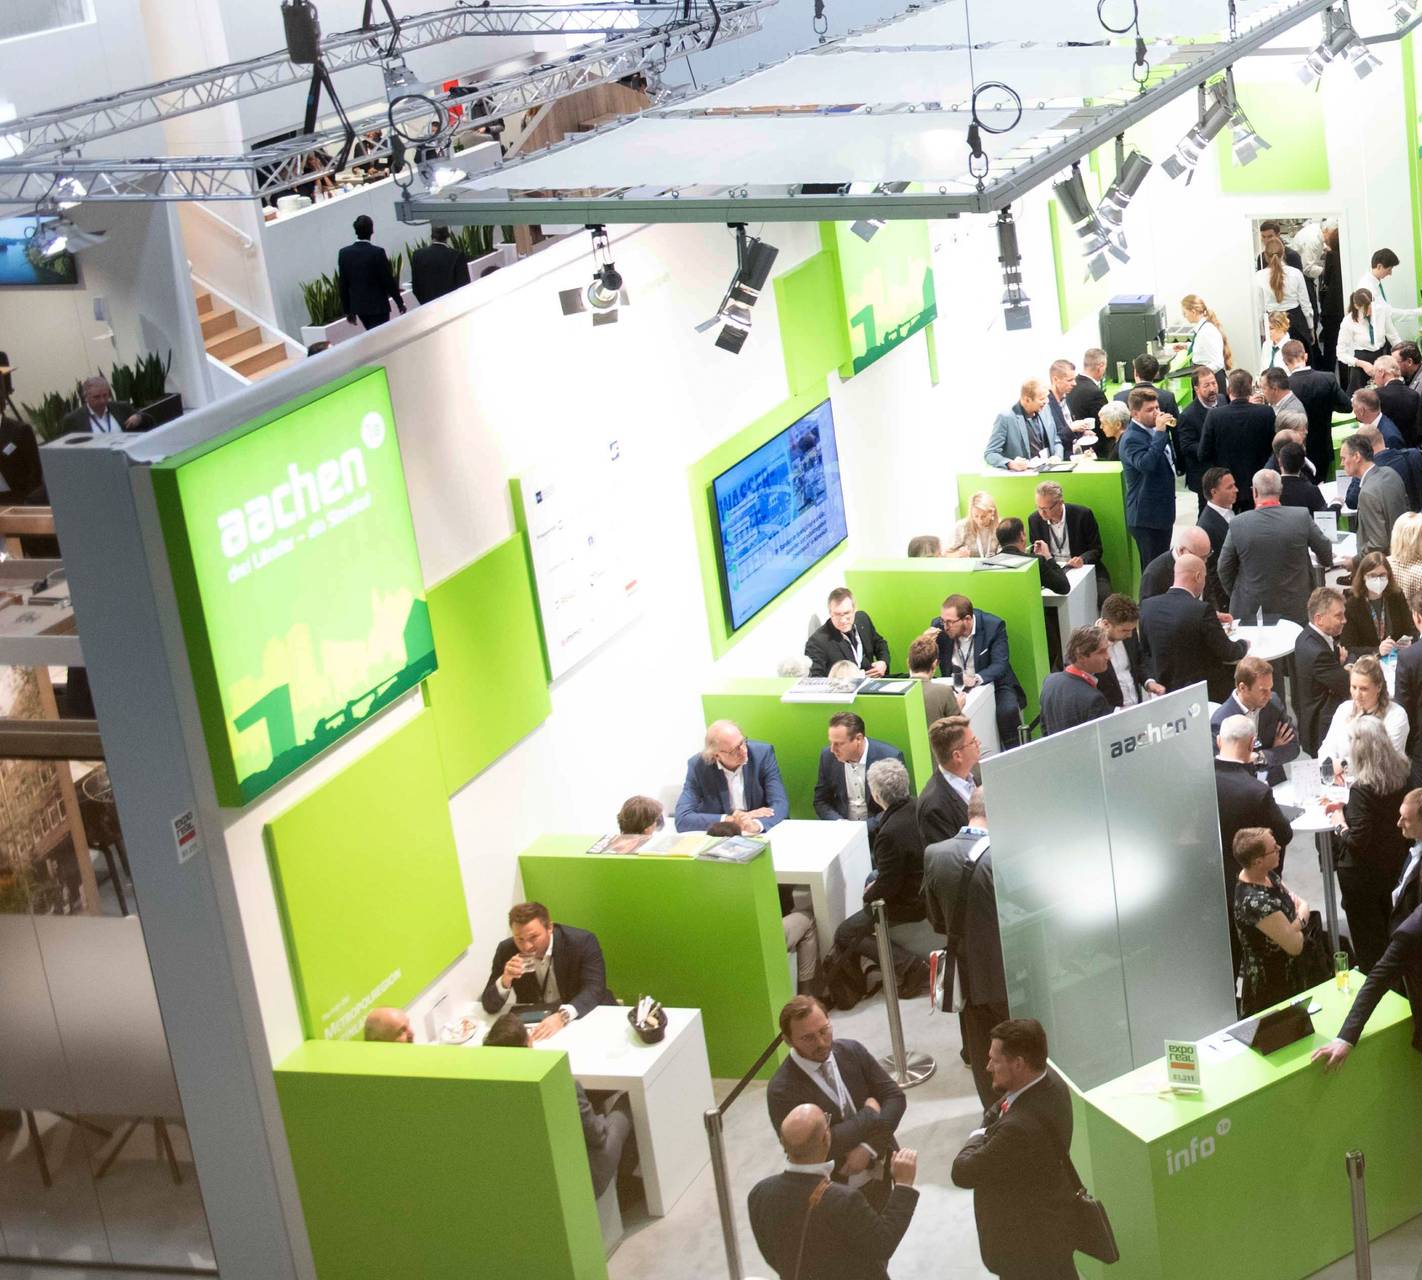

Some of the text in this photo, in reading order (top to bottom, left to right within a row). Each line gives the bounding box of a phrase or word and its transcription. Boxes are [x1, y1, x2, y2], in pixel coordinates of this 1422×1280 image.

[217, 447, 367, 558] aachen
[1110, 717, 1187, 758] aachen
[1169, 1044, 1194, 1057] expo
[1169, 1052, 1194, 1063] real
[1166, 1135, 1216, 1177] info
